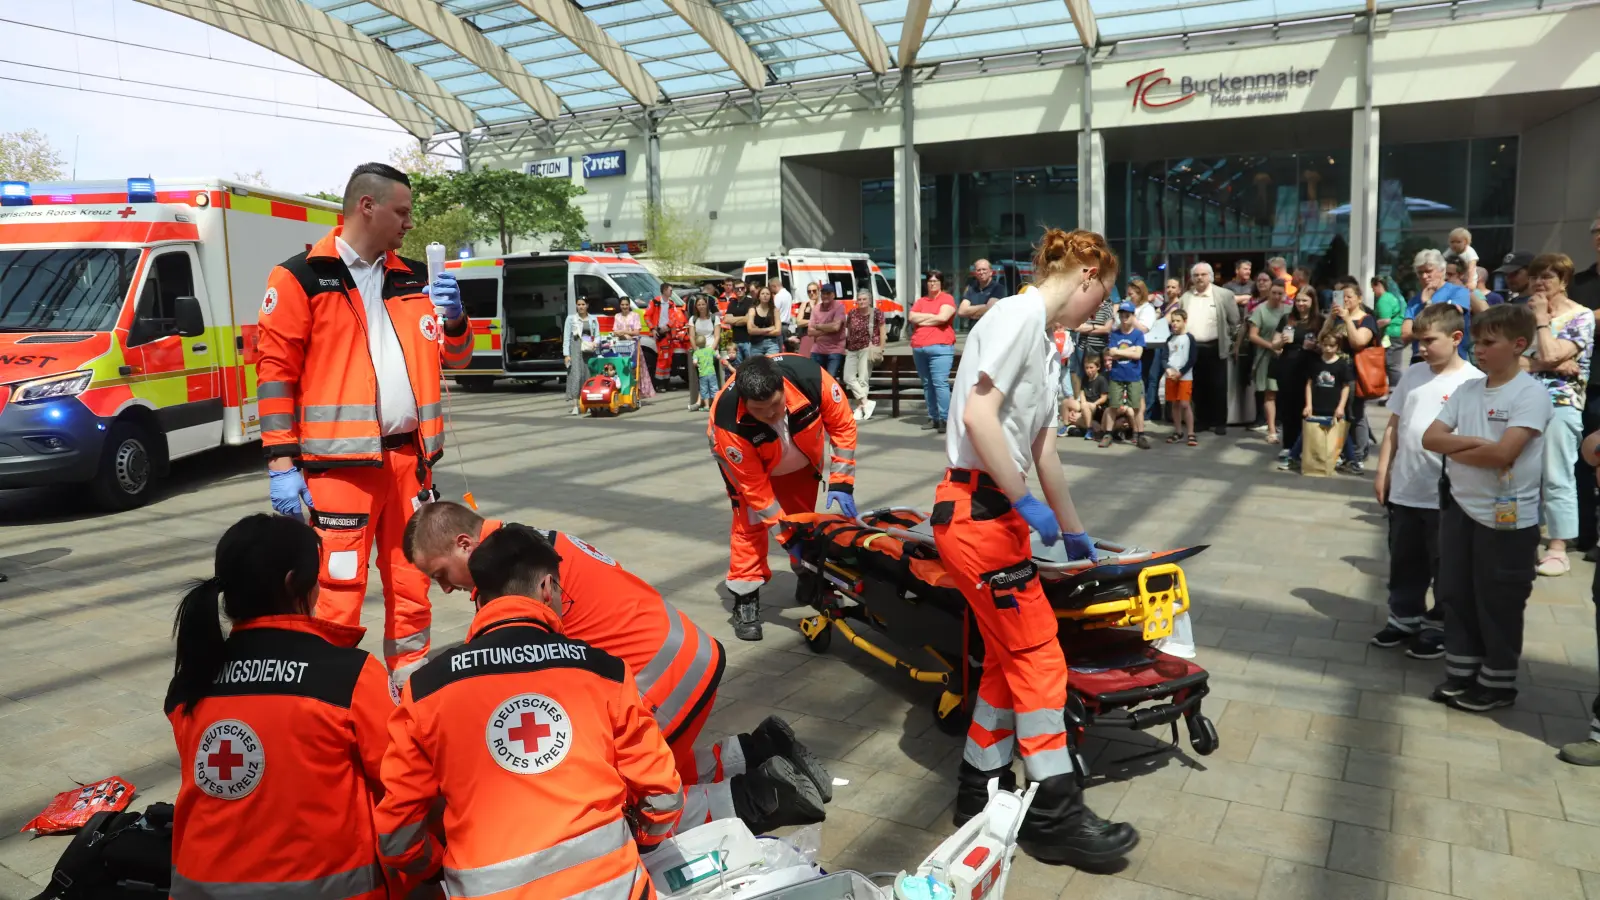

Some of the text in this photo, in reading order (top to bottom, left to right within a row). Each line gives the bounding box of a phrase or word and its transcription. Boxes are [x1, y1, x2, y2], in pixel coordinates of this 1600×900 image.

[1126, 66, 1319, 109] TC Buckenmaier
[529, 161, 562, 176] ACTION
[590, 155, 620, 171] JYSK
[0, 207, 112, 219] erisches Rotes Kreuz
[318, 516, 359, 527] RETTUNGSDIENST
[451, 642, 587, 672] RETTUNGSDIENST
[493, 698, 563, 729] DEUTSCHES
[202, 724, 257, 753] DEUTSCHES
[493, 731, 566, 769] ROTES KREUZ
[197, 761, 259, 795] ROTES KREUZ
